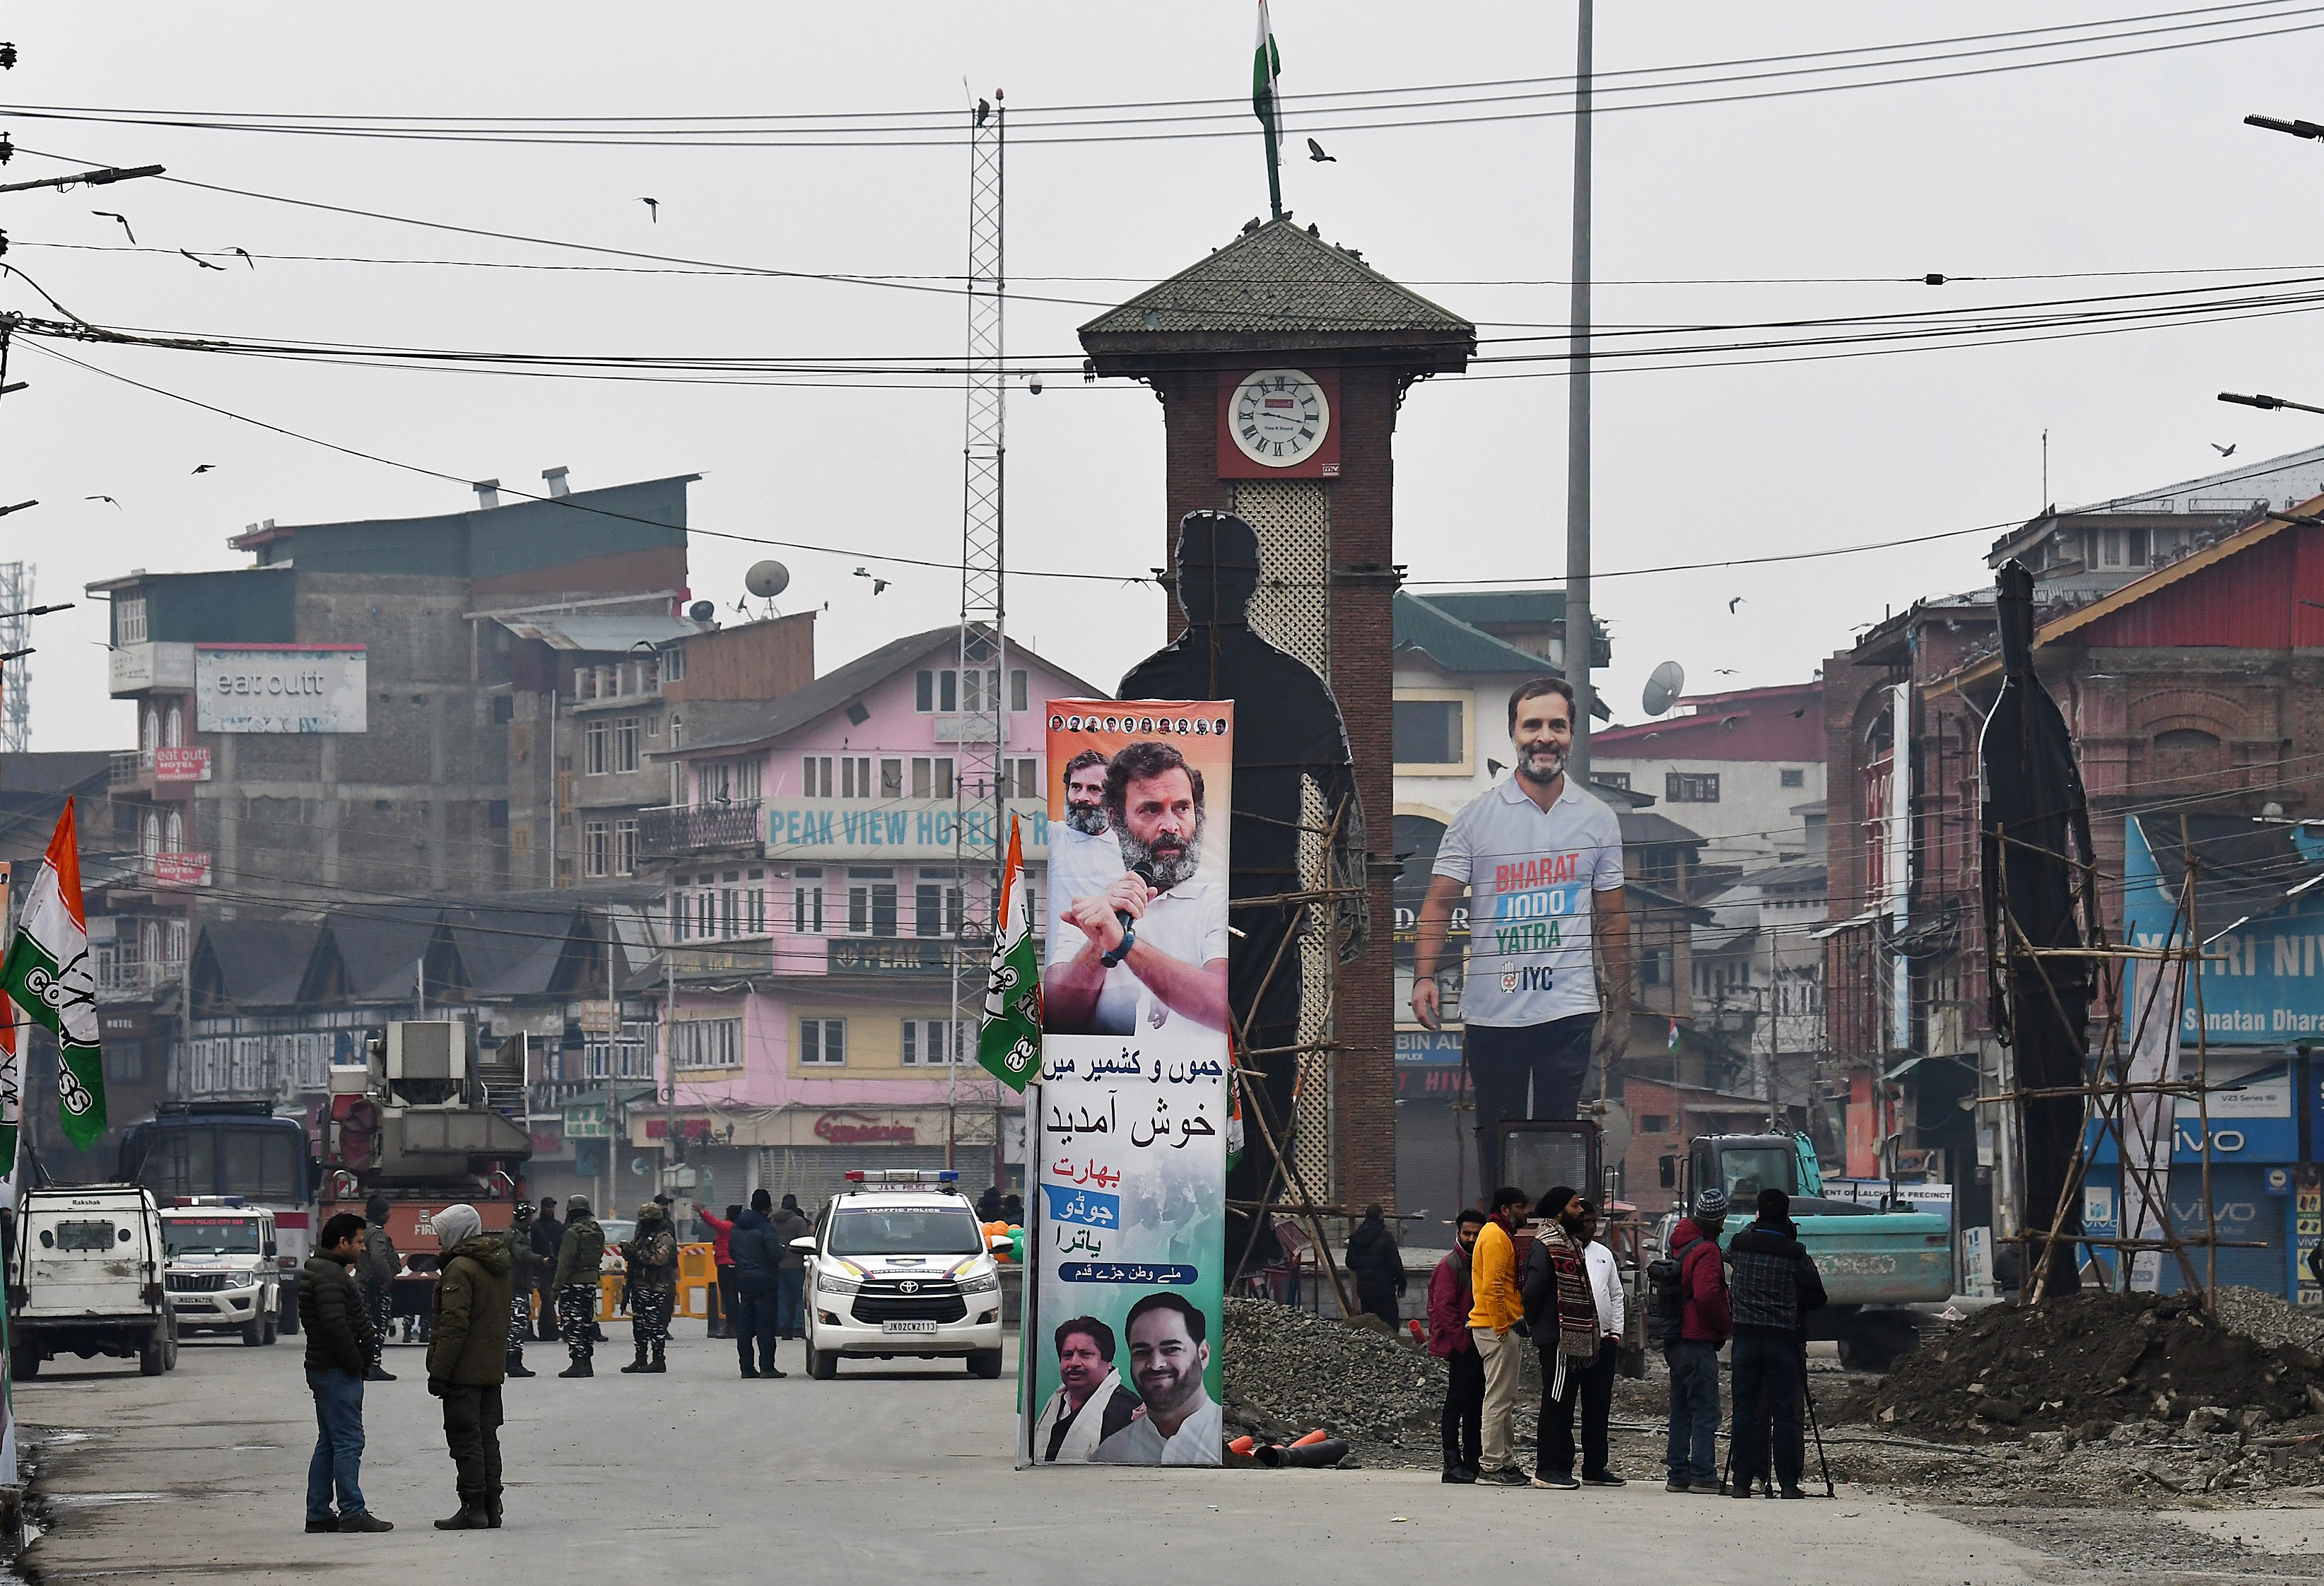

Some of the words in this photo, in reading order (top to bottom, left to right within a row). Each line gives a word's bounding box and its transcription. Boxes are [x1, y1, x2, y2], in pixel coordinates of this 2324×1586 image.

[218, 671, 262, 695] eat
[267, 671, 324, 695] outt
[157, 749, 177, 761] eat
[770, 810, 834, 845] PEAK
[843, 810, 908, 846] VIEW
[1496, 853, 1580, 893] BHARAT
[1503, 890, 1566, 922] JODO
[1496, 920, 1561, 955] YATRA
[864, 945, 922, 969] PEAK
[1522, 966, 1554, 991] IYC
[1042, 1059, 1075, 1081] میں
[1081, 1047, 1142, 1082] کشمیر
[1148, 1059, 1161, 1083] و
[1168, 1059, 1223, 1084] جموں
[1047, 1089, 1118, 1146] آمدید
[1131, 1097, 1216, 1149] خوش
[2174, 1124, 2245, 1152] ivo
[1052, 1158, 1121, 1189] بھارت
[1059, 1191, 1114, 1226] جوڈو
[1055, 1225, 1102, 1259] یاترا
[1075, 1264, 1092, 1281] قدم
[1096, 1264, 1125, 1280] جڑے
[1129, 1267, 1154, 1280] وطن
[1157, 1267, 1181, 1284] ملے
[888, 1322, 935, 1331] JK02CW2113
